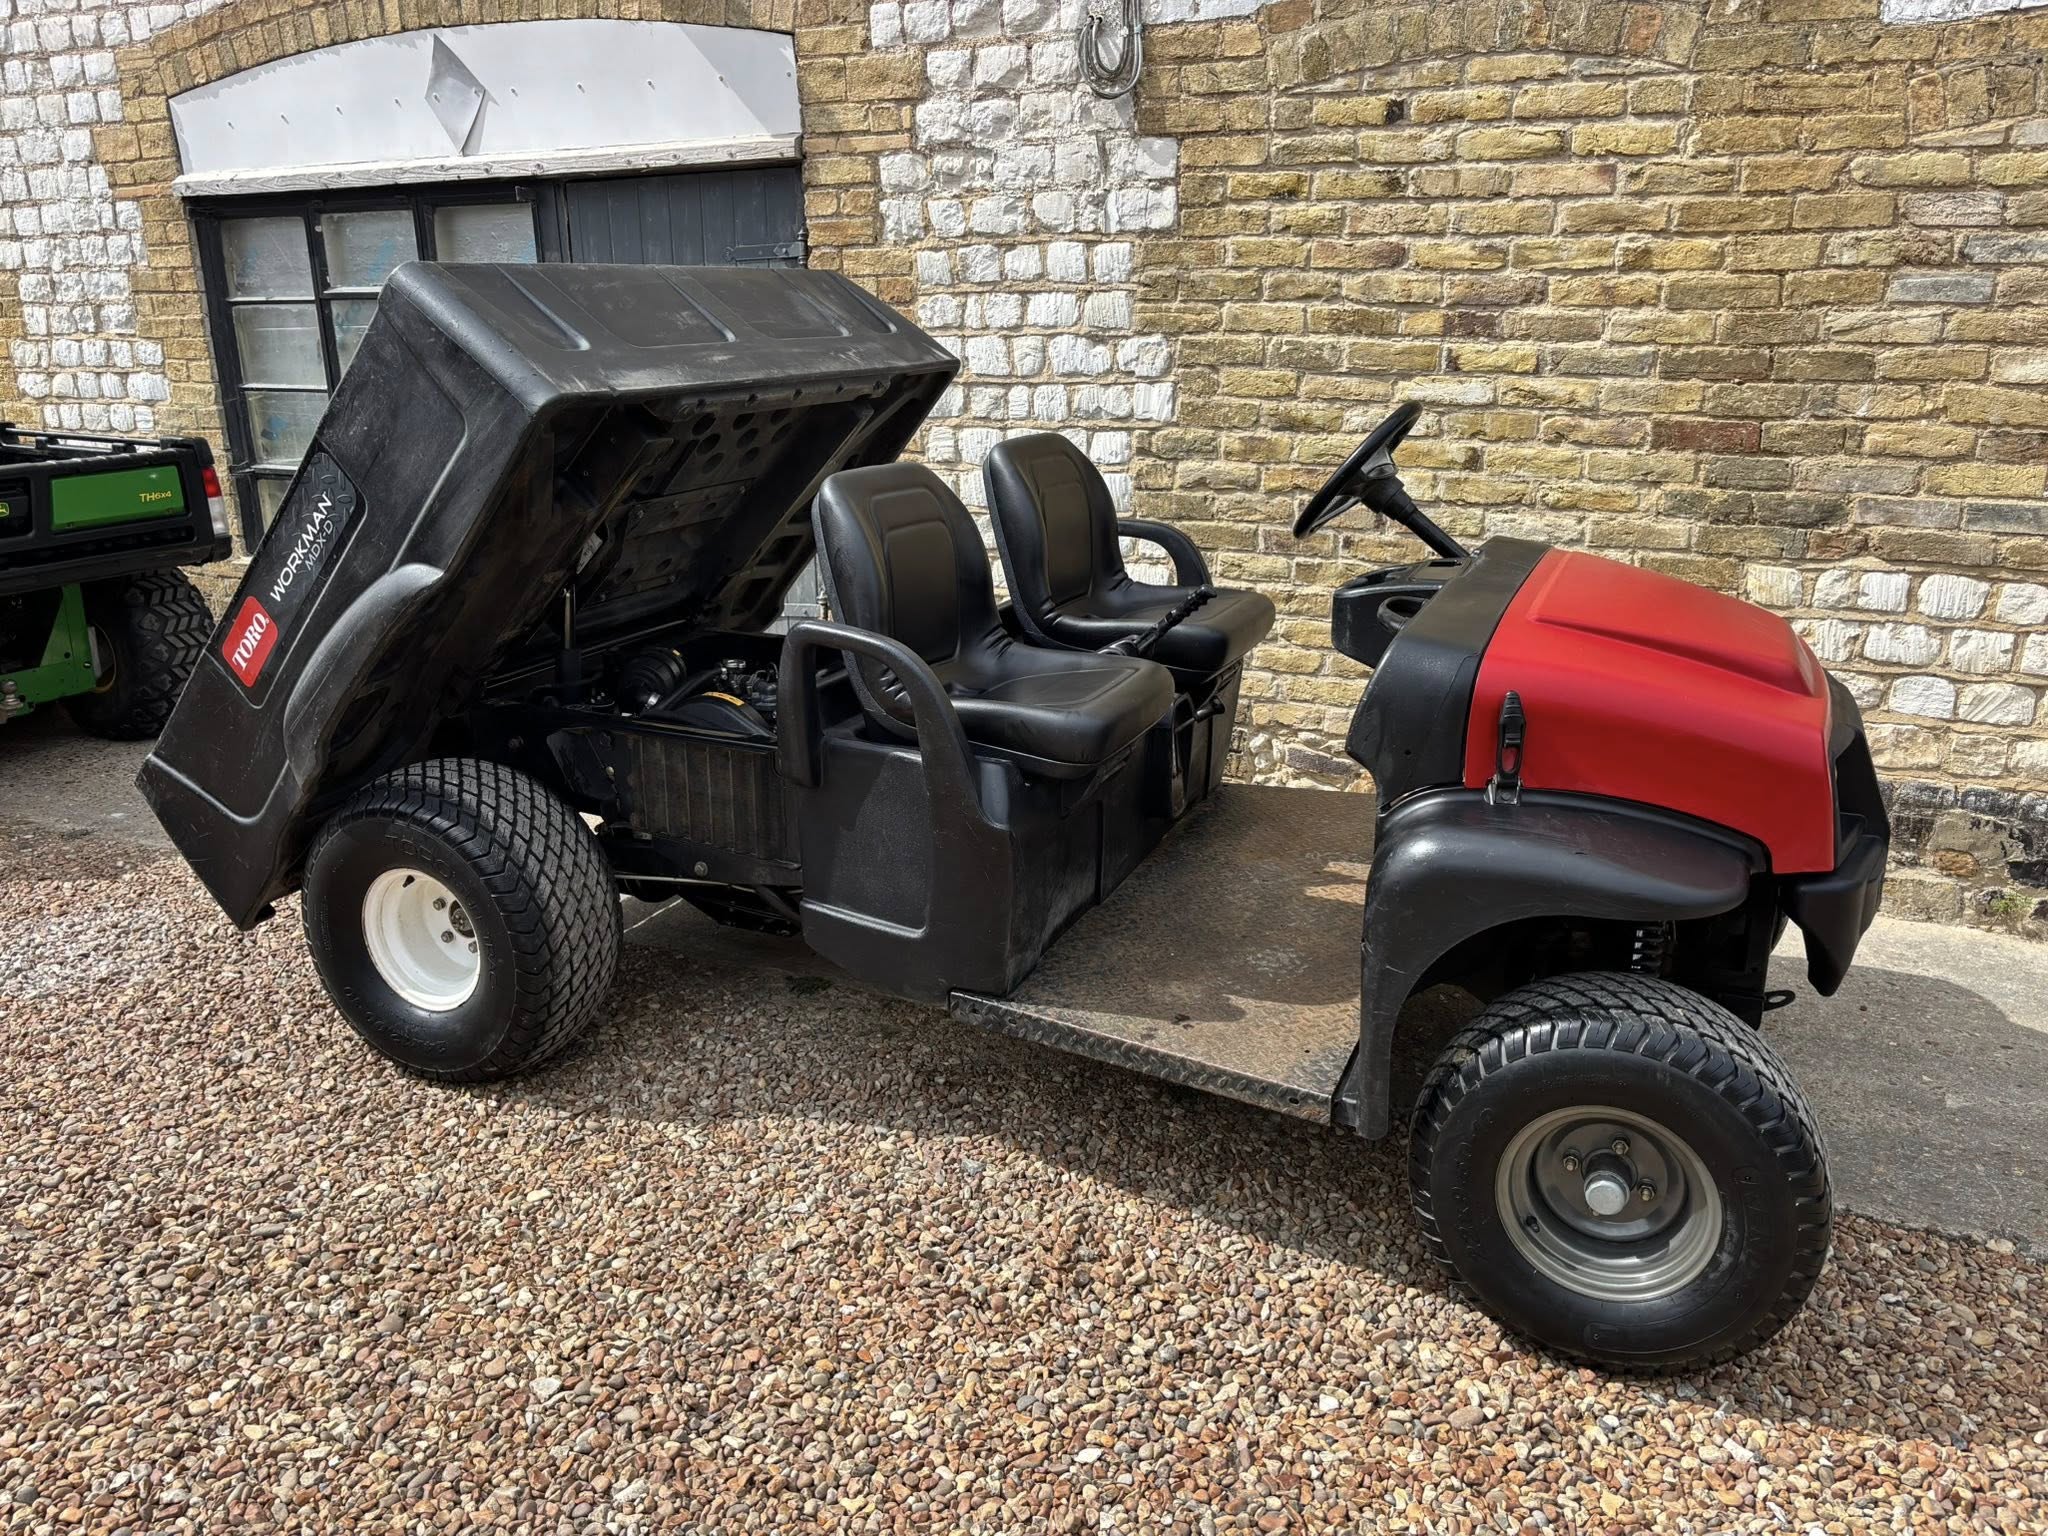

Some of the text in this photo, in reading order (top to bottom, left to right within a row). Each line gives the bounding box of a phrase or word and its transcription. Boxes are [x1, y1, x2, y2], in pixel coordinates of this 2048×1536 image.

[139, 491, 172, 503] TH6x4
[270, 493, 333, 602] WORKMAN
[305, 520, 333, 571] MDX-D
[232, 612, 268, 671] TORO
